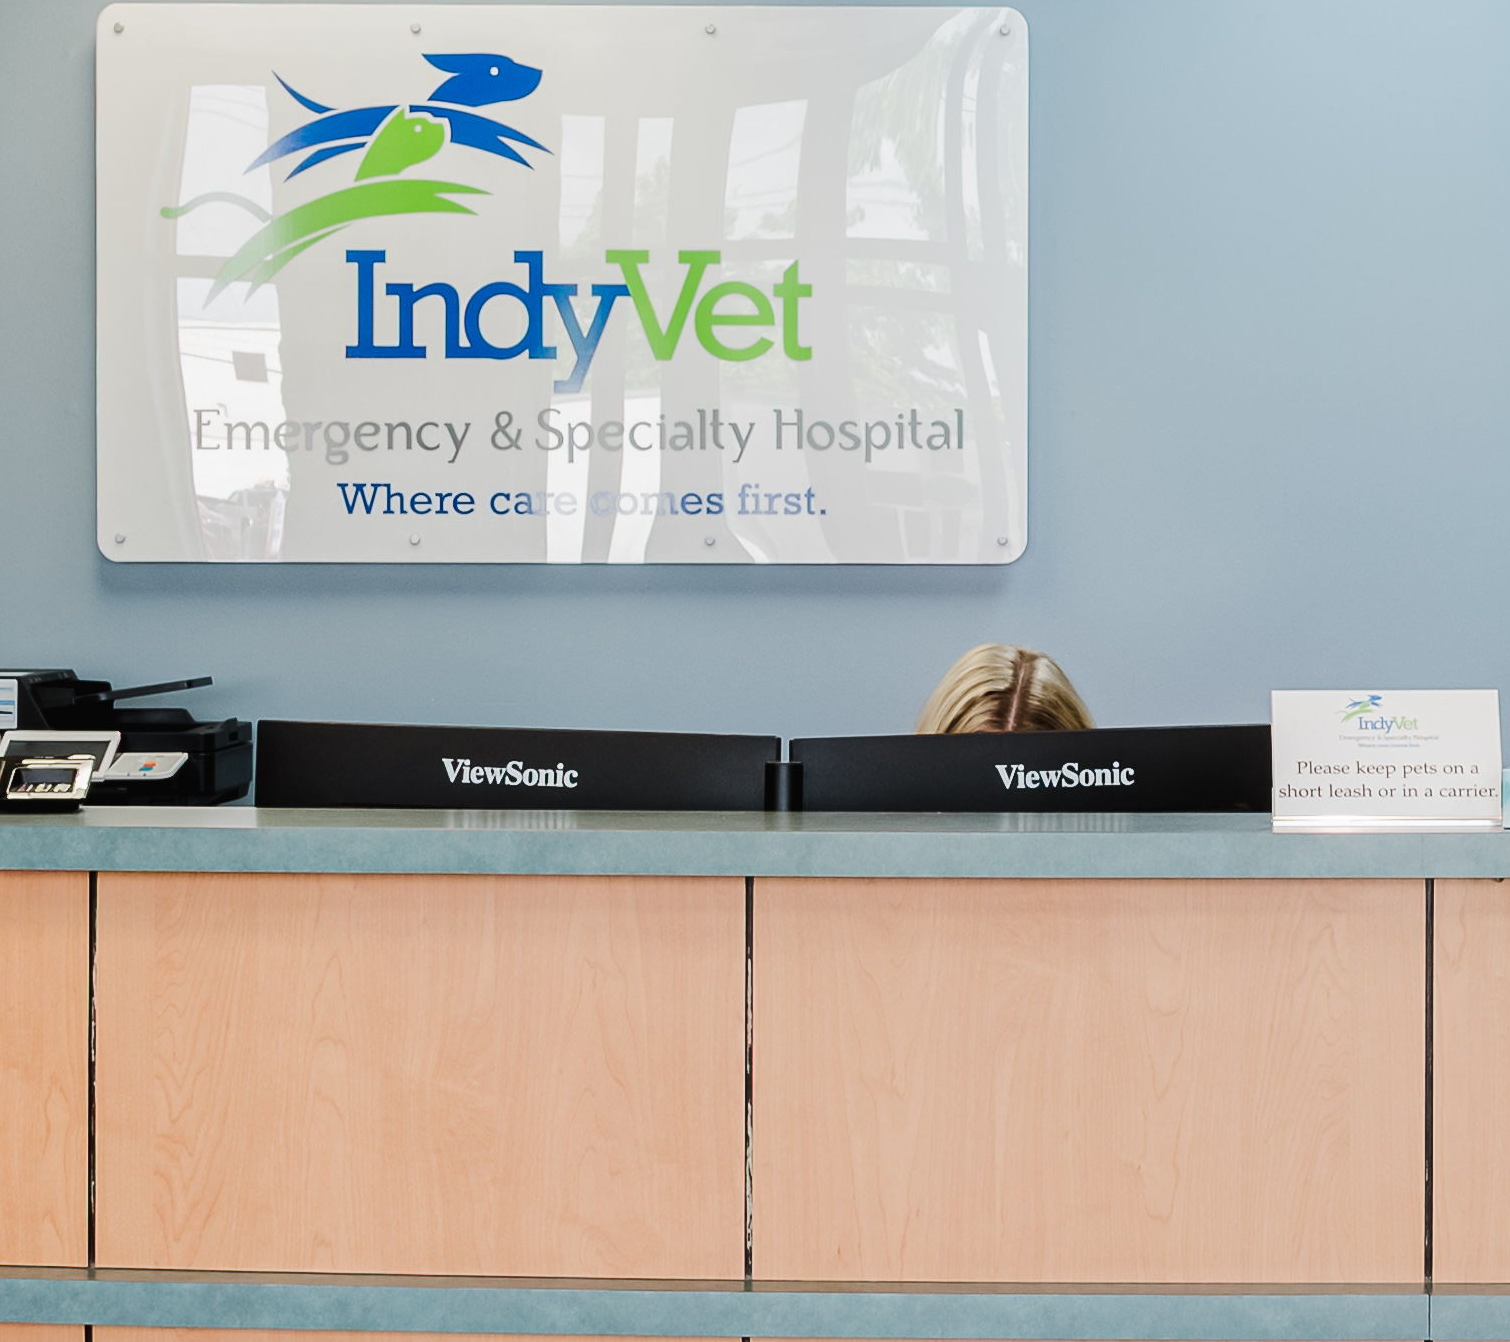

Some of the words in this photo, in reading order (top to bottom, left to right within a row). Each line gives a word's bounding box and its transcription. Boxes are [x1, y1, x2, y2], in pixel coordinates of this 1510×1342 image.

[345, 250, 812, 394] IndyVet
[192, 409, 472, 465] Emergency
[490, 412, 523, 452] &
[535, 408, 755, 463] Specialty
[774, 409, 965, 463] Hospital
[337, 483, 475, 516] Where
[489, 490, 578, 516] care
[591, 490, 725, 516] comes
[738, 483, 828, 516] first.
[1358, 716, 1418, 733] IndyVet
[442, 758, 578, 788] ViewSonic
[995, 761, 1135, 789] ViewSonic
[1296, 761, 1350, 775] Please
[1356, 761, 1396, 778] keep
[1402, 762, 1437, 778] pets
[1443, 764, 1464, 775] on
[1470, 764, 1479, 775] a
[1279, 784, 1323, 798] short
[1329, 784, 1372, 798] leash
[1378, 787, 1396, 798] or
[1402, 784, 1418, 798] in
[1424, 787, 1433, 798] a
[1439, 784, 1499, 798] carrier.
